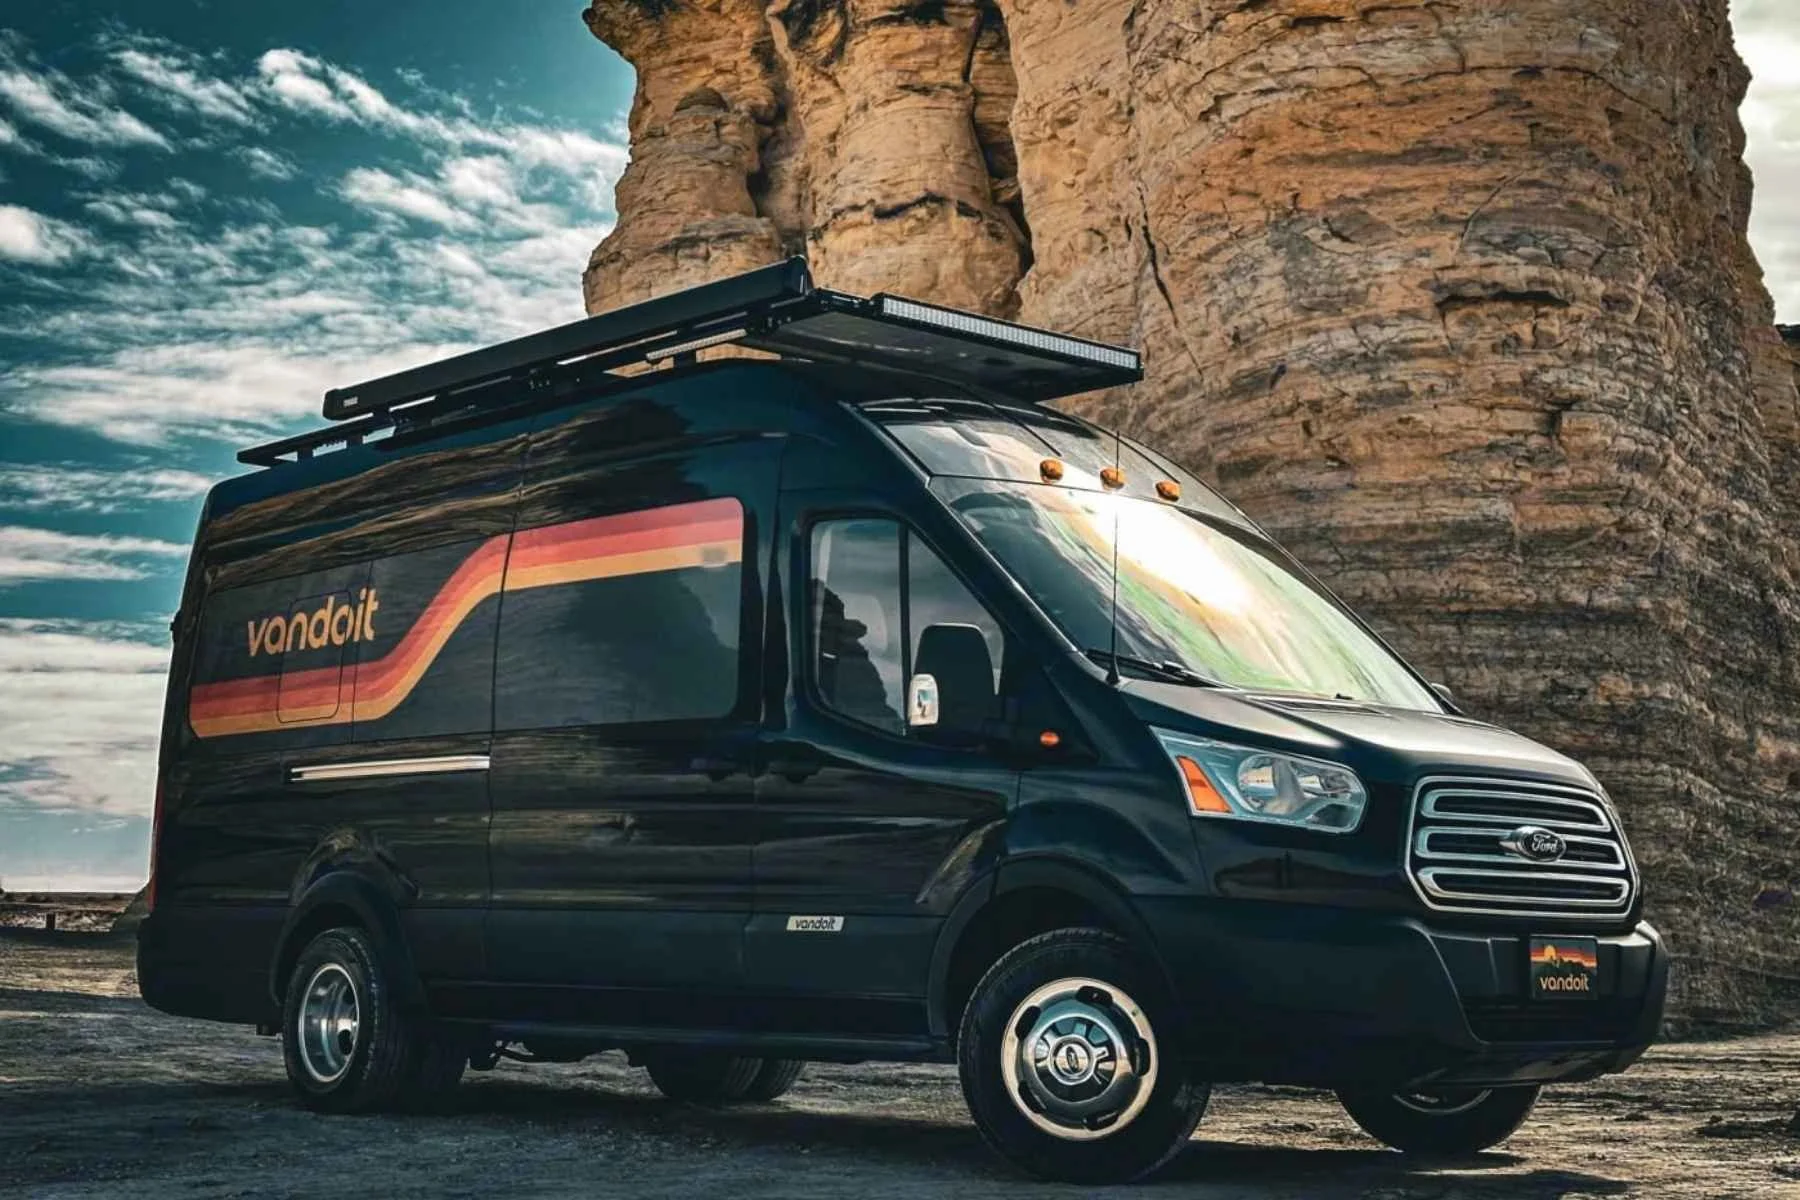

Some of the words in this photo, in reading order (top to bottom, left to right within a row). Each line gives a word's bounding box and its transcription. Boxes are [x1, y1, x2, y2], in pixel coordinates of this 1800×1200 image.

[248, 588, 379, 656] vandoit
[1532, 833, 1558, 853] Ford
[795, 917, 836, 929] vandoit
[1540, 973, 1589, 991] vandoit
